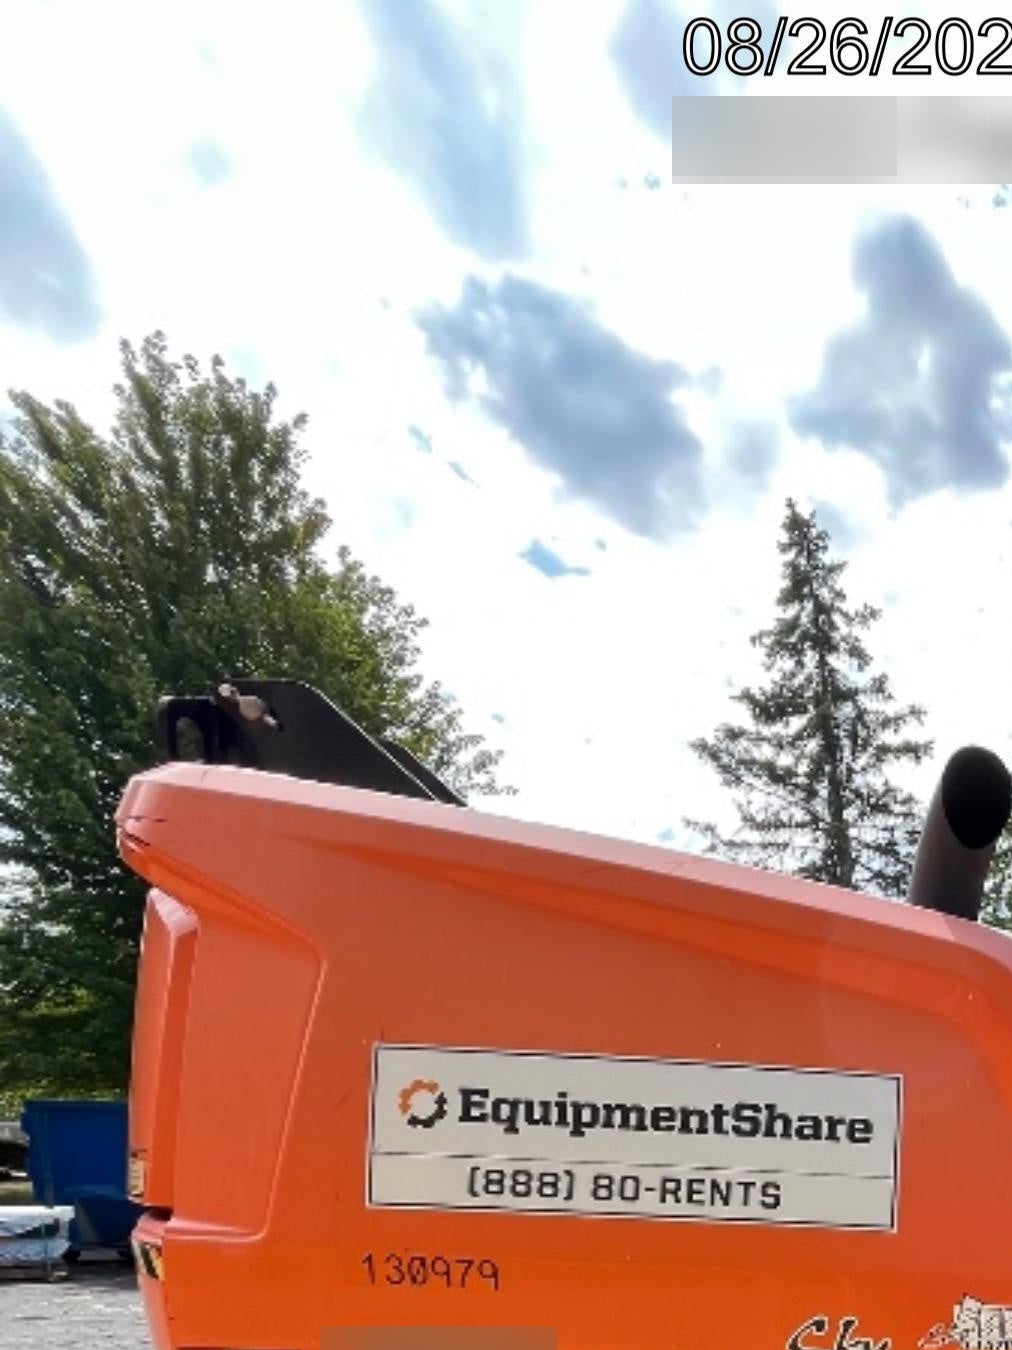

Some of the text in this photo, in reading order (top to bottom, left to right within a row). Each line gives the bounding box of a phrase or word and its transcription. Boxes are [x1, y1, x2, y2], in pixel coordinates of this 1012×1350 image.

[457, 1087, 874, 1145] EquipmentShare
[591, 1174, 782, 1210] 80-RENTS
[361, 1252, 500, 1291] 130979
